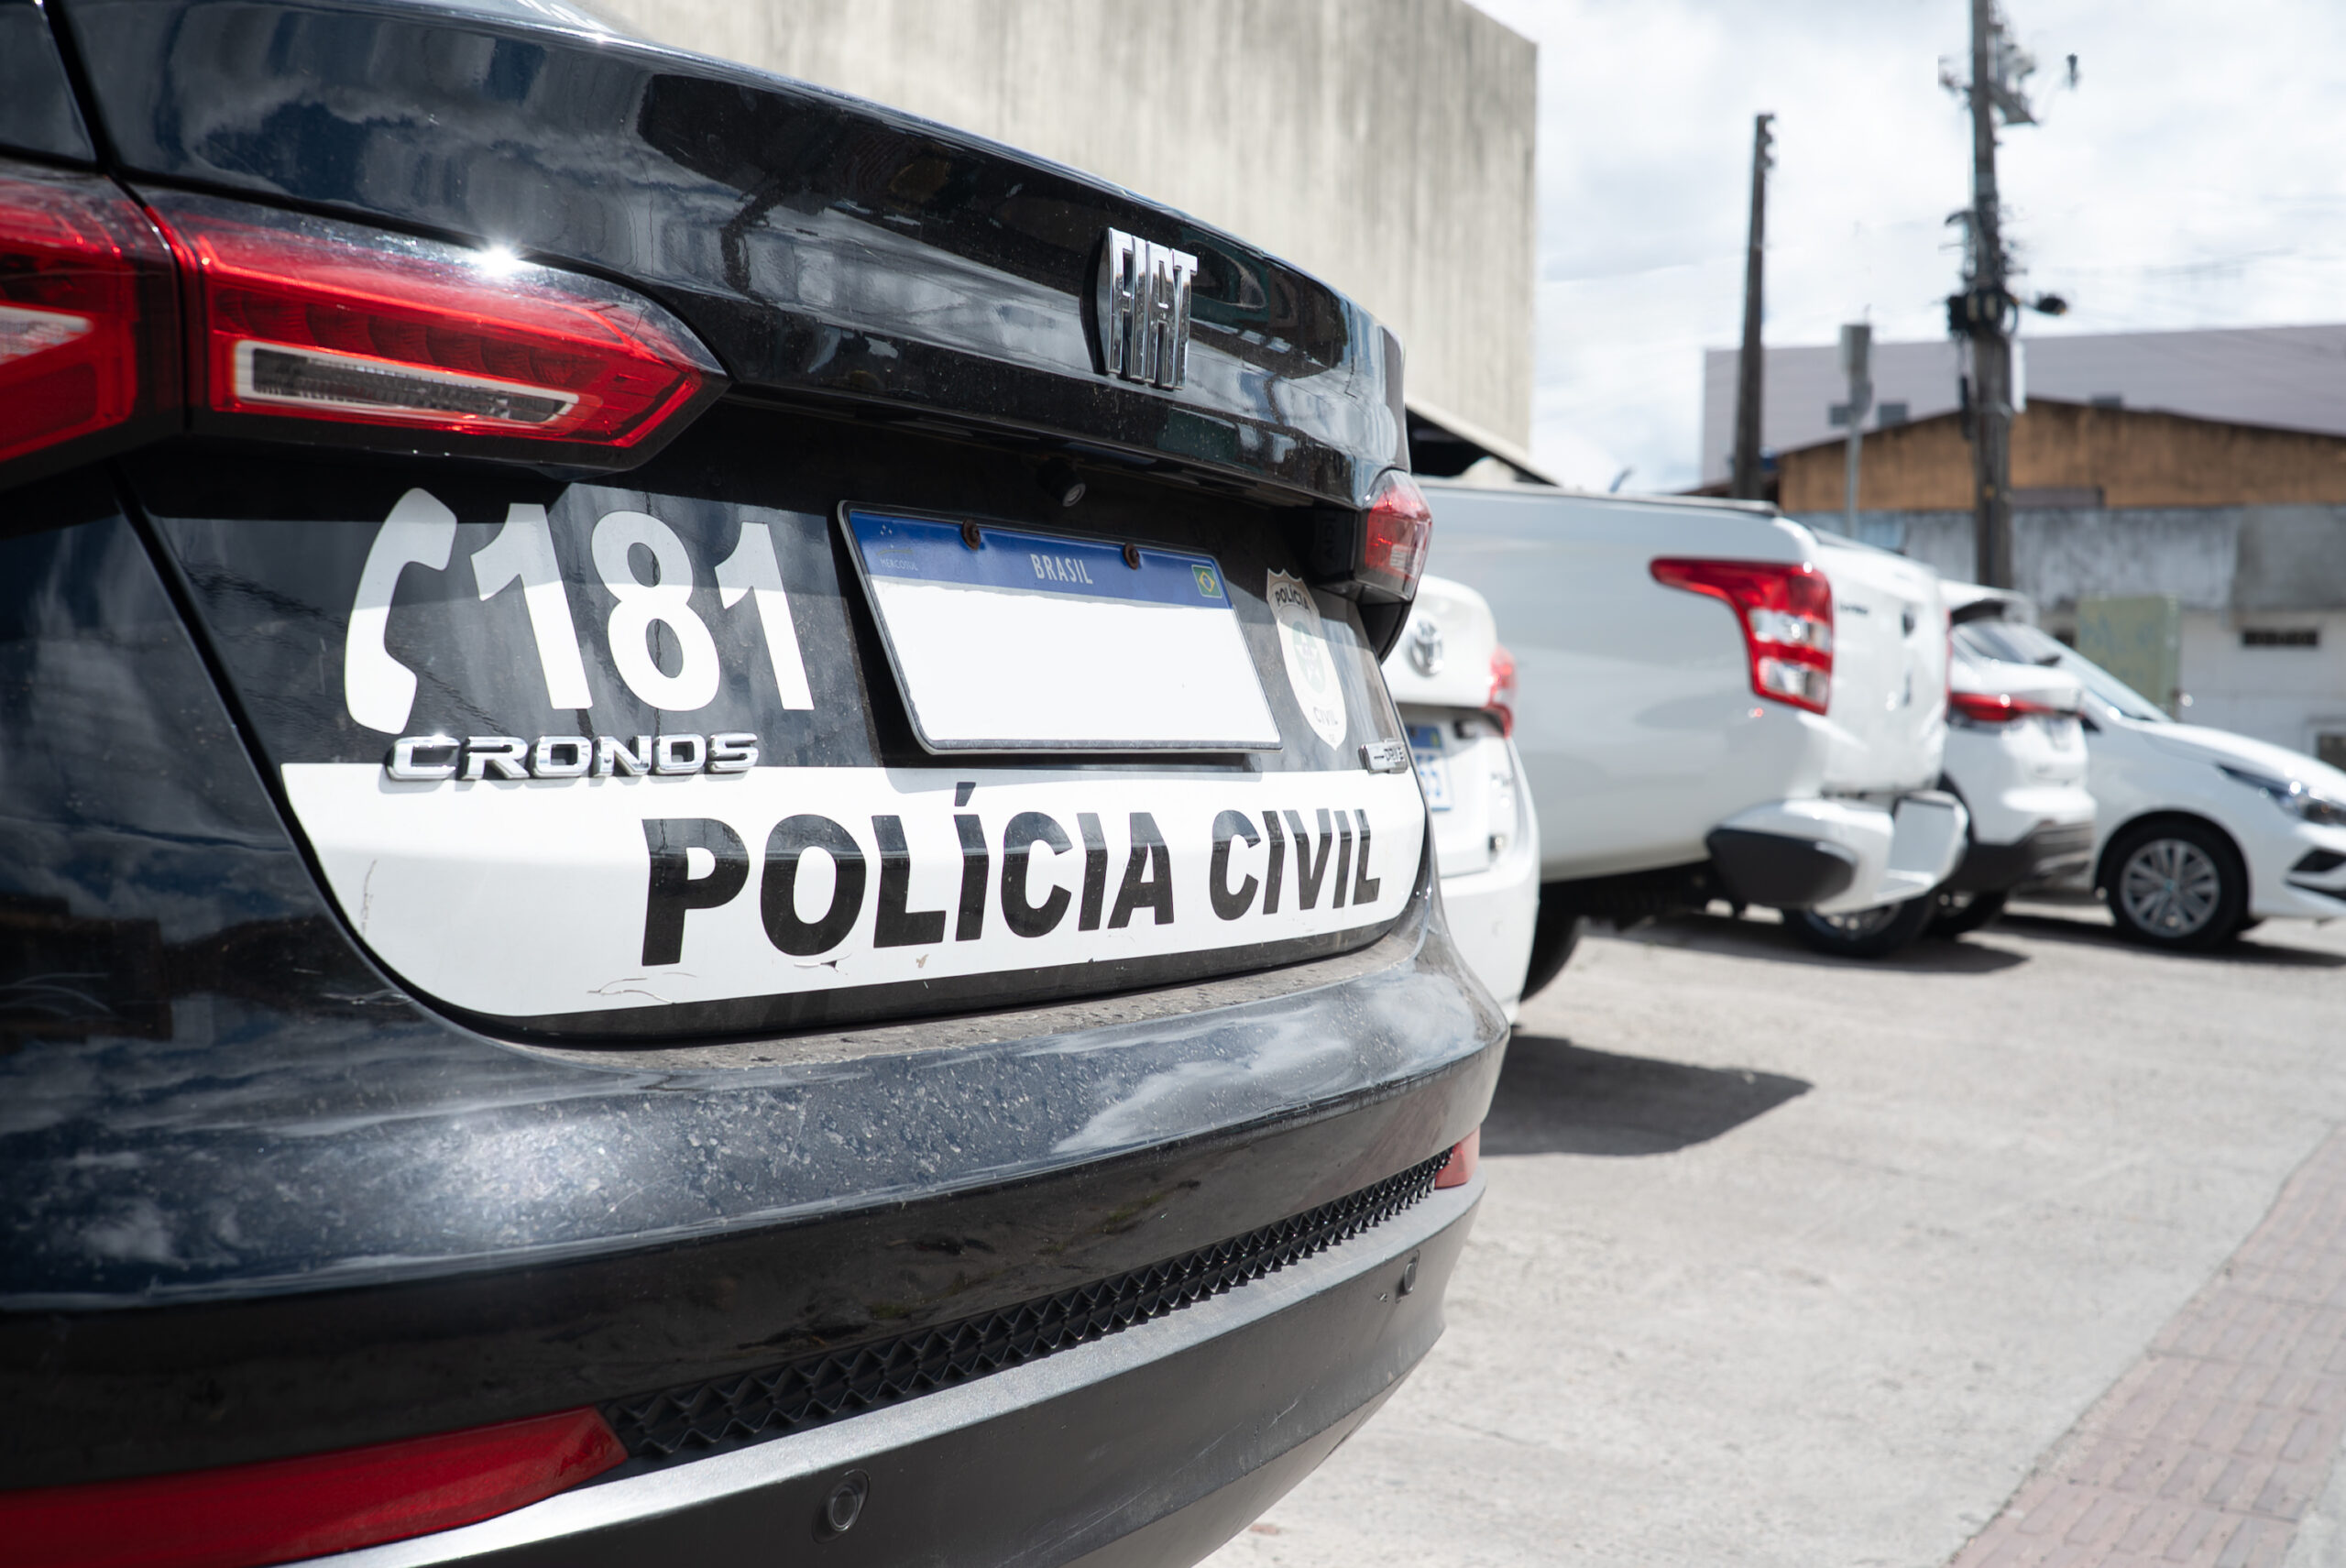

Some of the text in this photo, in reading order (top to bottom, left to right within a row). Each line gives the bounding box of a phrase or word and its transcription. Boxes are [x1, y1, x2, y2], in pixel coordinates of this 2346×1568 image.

[1108, 227, 1198, 390] FIAT
[470, 503, 815, 711] 181
[1030, 554, 1093, 584] BRASIL
[386, 733, 759, 780] CRONOS
[641, 782, 1381, 965] POLÍCIA CIVIL
